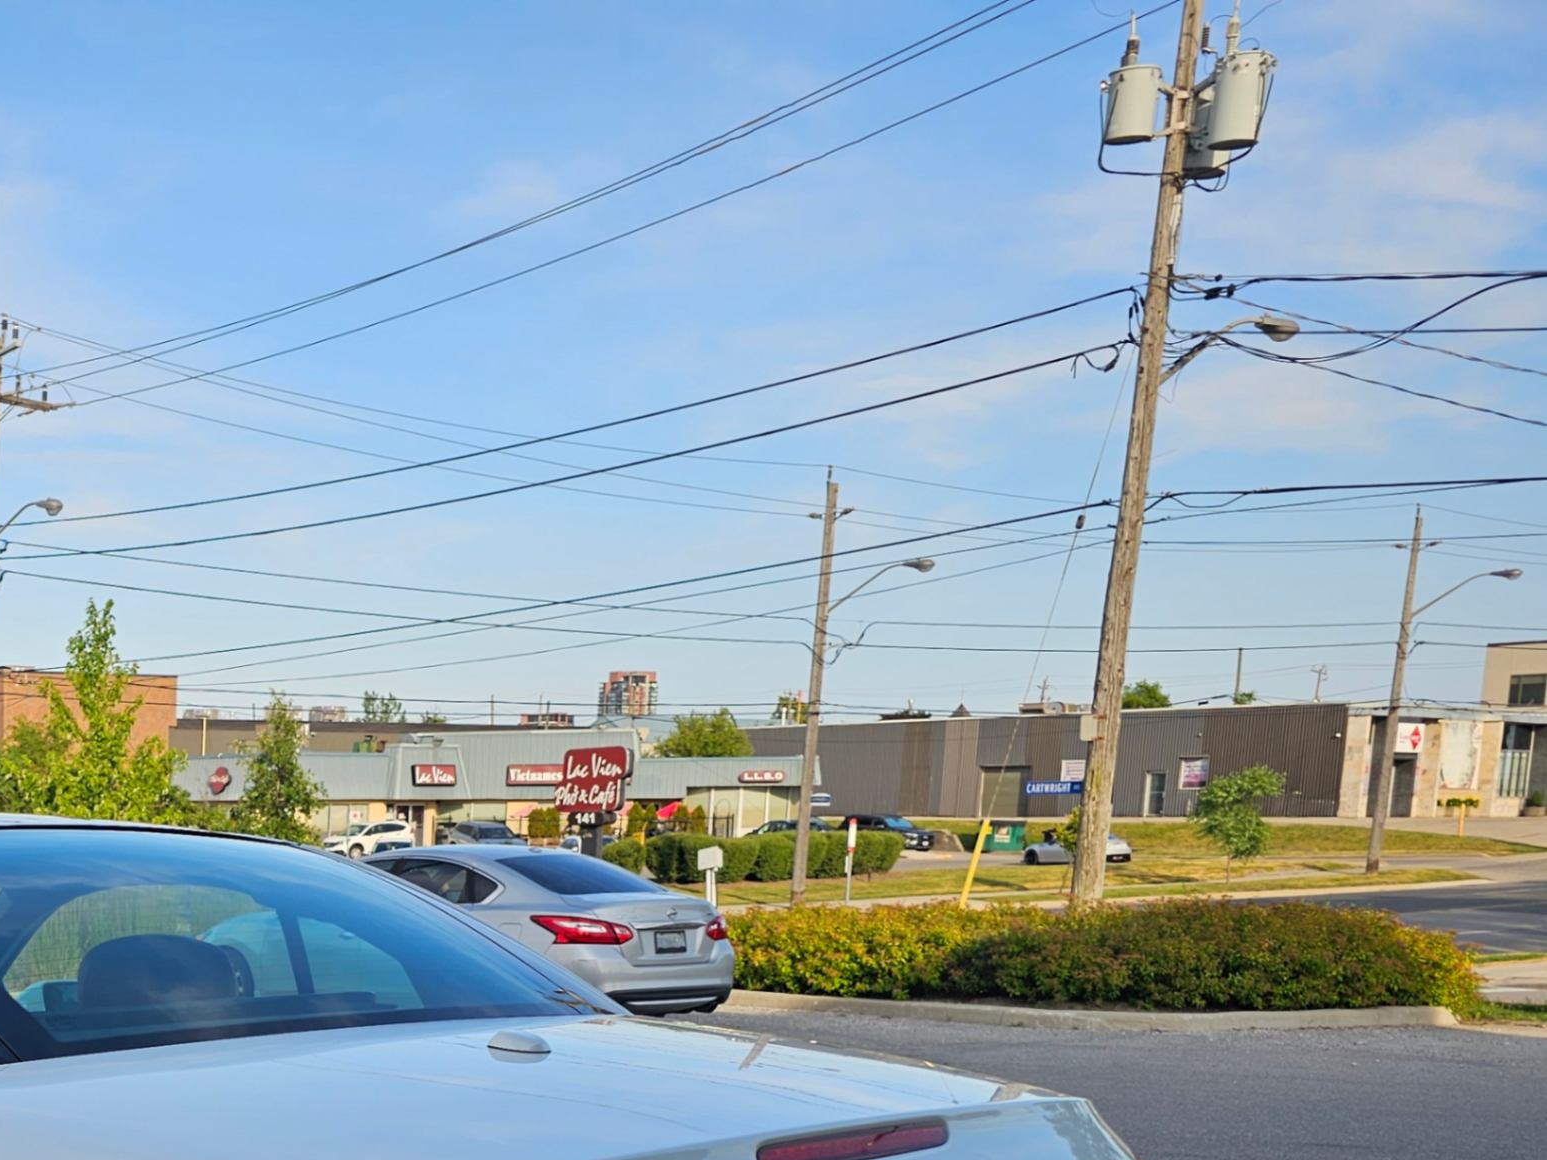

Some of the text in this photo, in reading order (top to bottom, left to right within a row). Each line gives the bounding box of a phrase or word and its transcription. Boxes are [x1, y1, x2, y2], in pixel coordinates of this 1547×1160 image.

[415, 766, 455, 784] Lac Vien
[566, 753, 622, 779] Lac Vien
[578, 788, 589, 805] &
[588, 781, 616, 810] Café
[1026, 782, 1071, 794] CARTWRIGHT
[575, 812, 595, 824] 141
